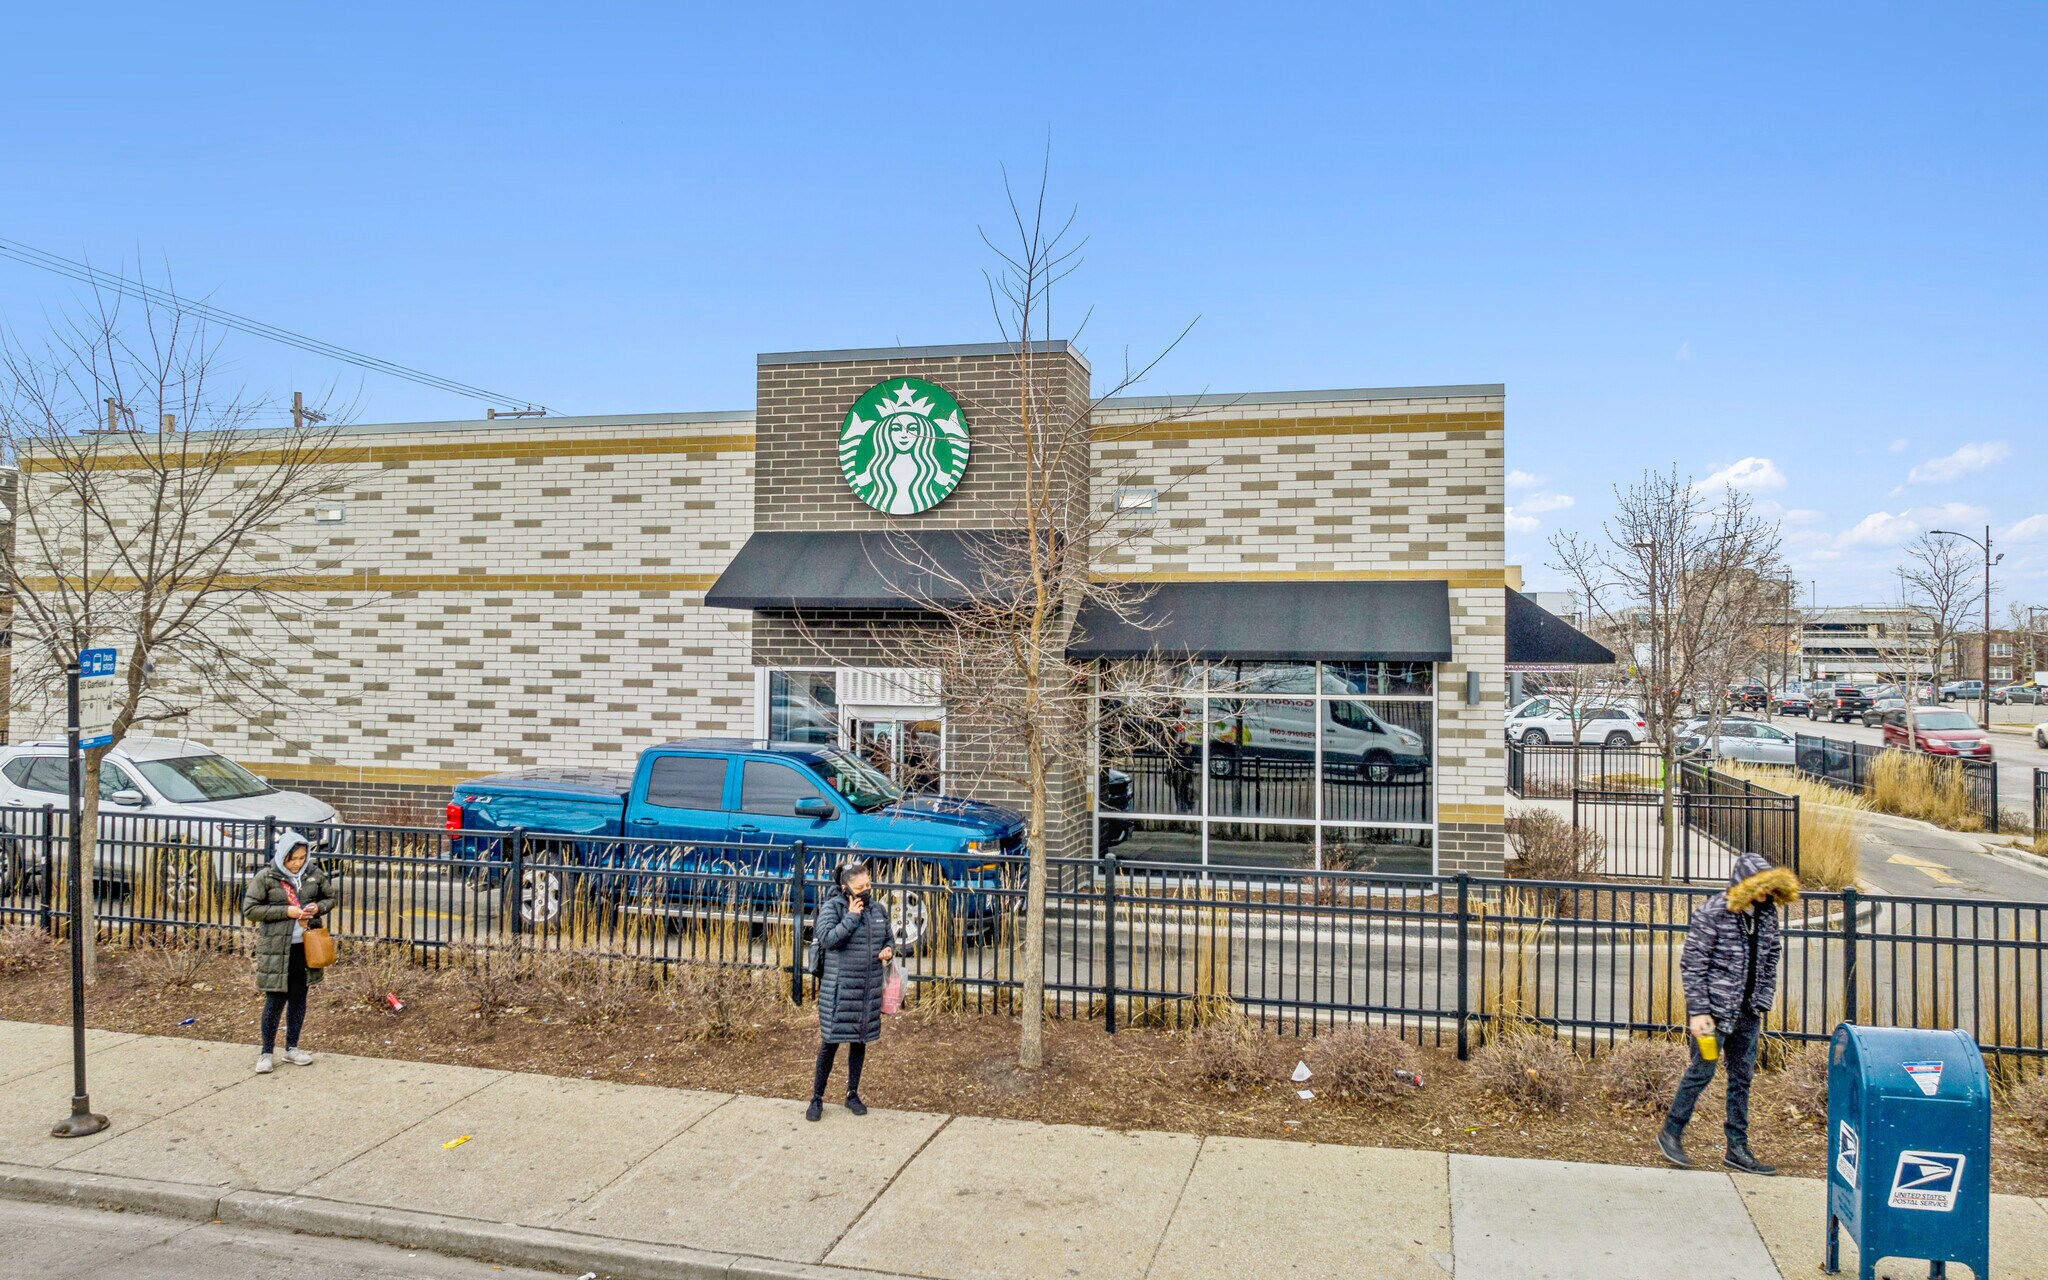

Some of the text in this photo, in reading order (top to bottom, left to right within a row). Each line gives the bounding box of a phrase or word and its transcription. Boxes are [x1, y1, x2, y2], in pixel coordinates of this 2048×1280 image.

[103, 653, 113, 661] bus
[102, 663, 114, 672] stop
[87, 680, 106, 689] Garfield
[1892, 1198, 1948, 1208] POSTAL SERVICE
